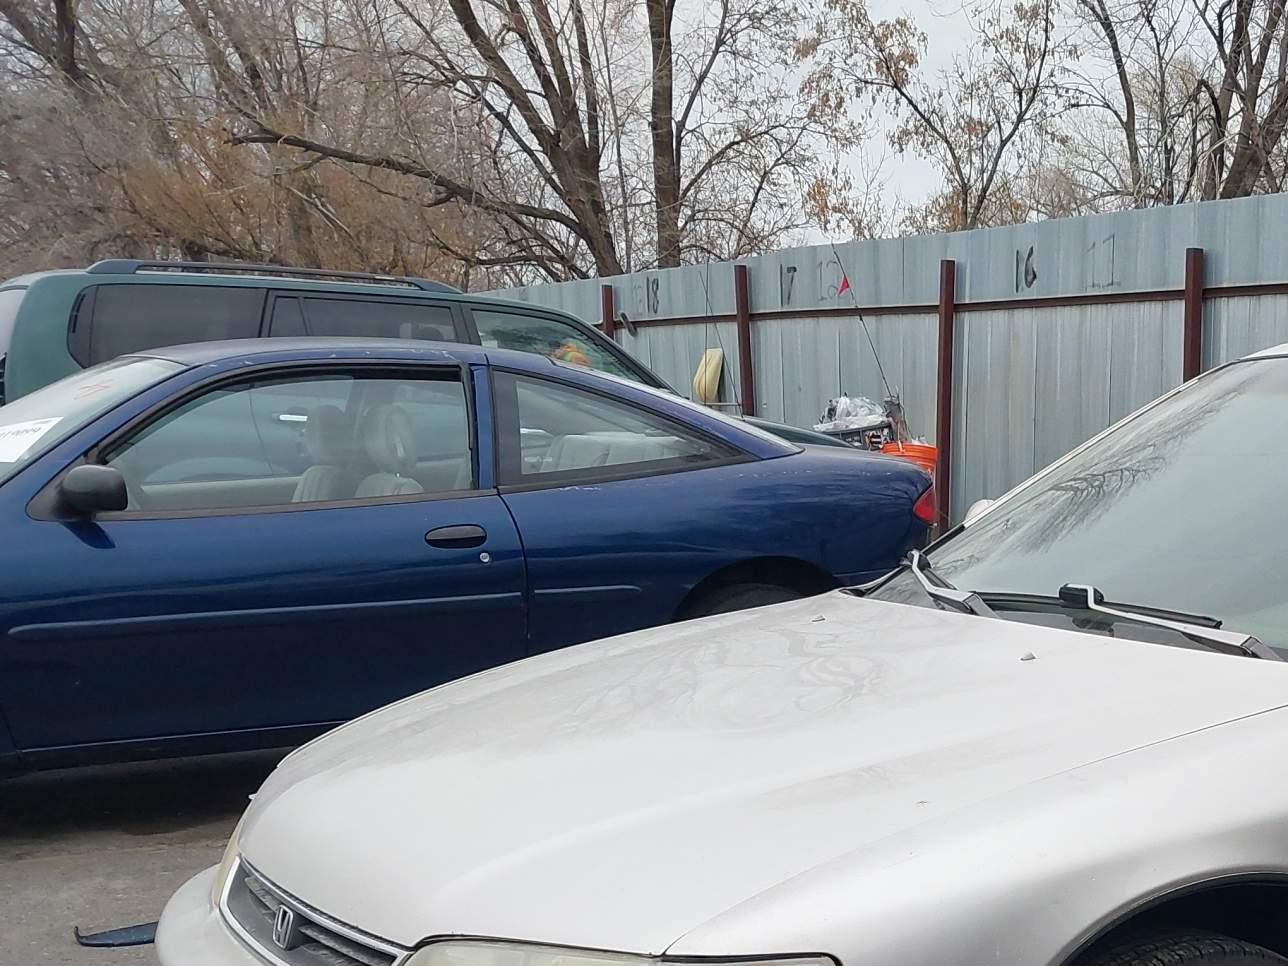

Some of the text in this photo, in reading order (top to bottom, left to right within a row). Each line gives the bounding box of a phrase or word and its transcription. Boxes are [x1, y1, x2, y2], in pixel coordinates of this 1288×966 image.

[779, 263, 798, 308] 17
[1015, 245, 1038, 293] 16
[646, 276, 660, 314] 18
